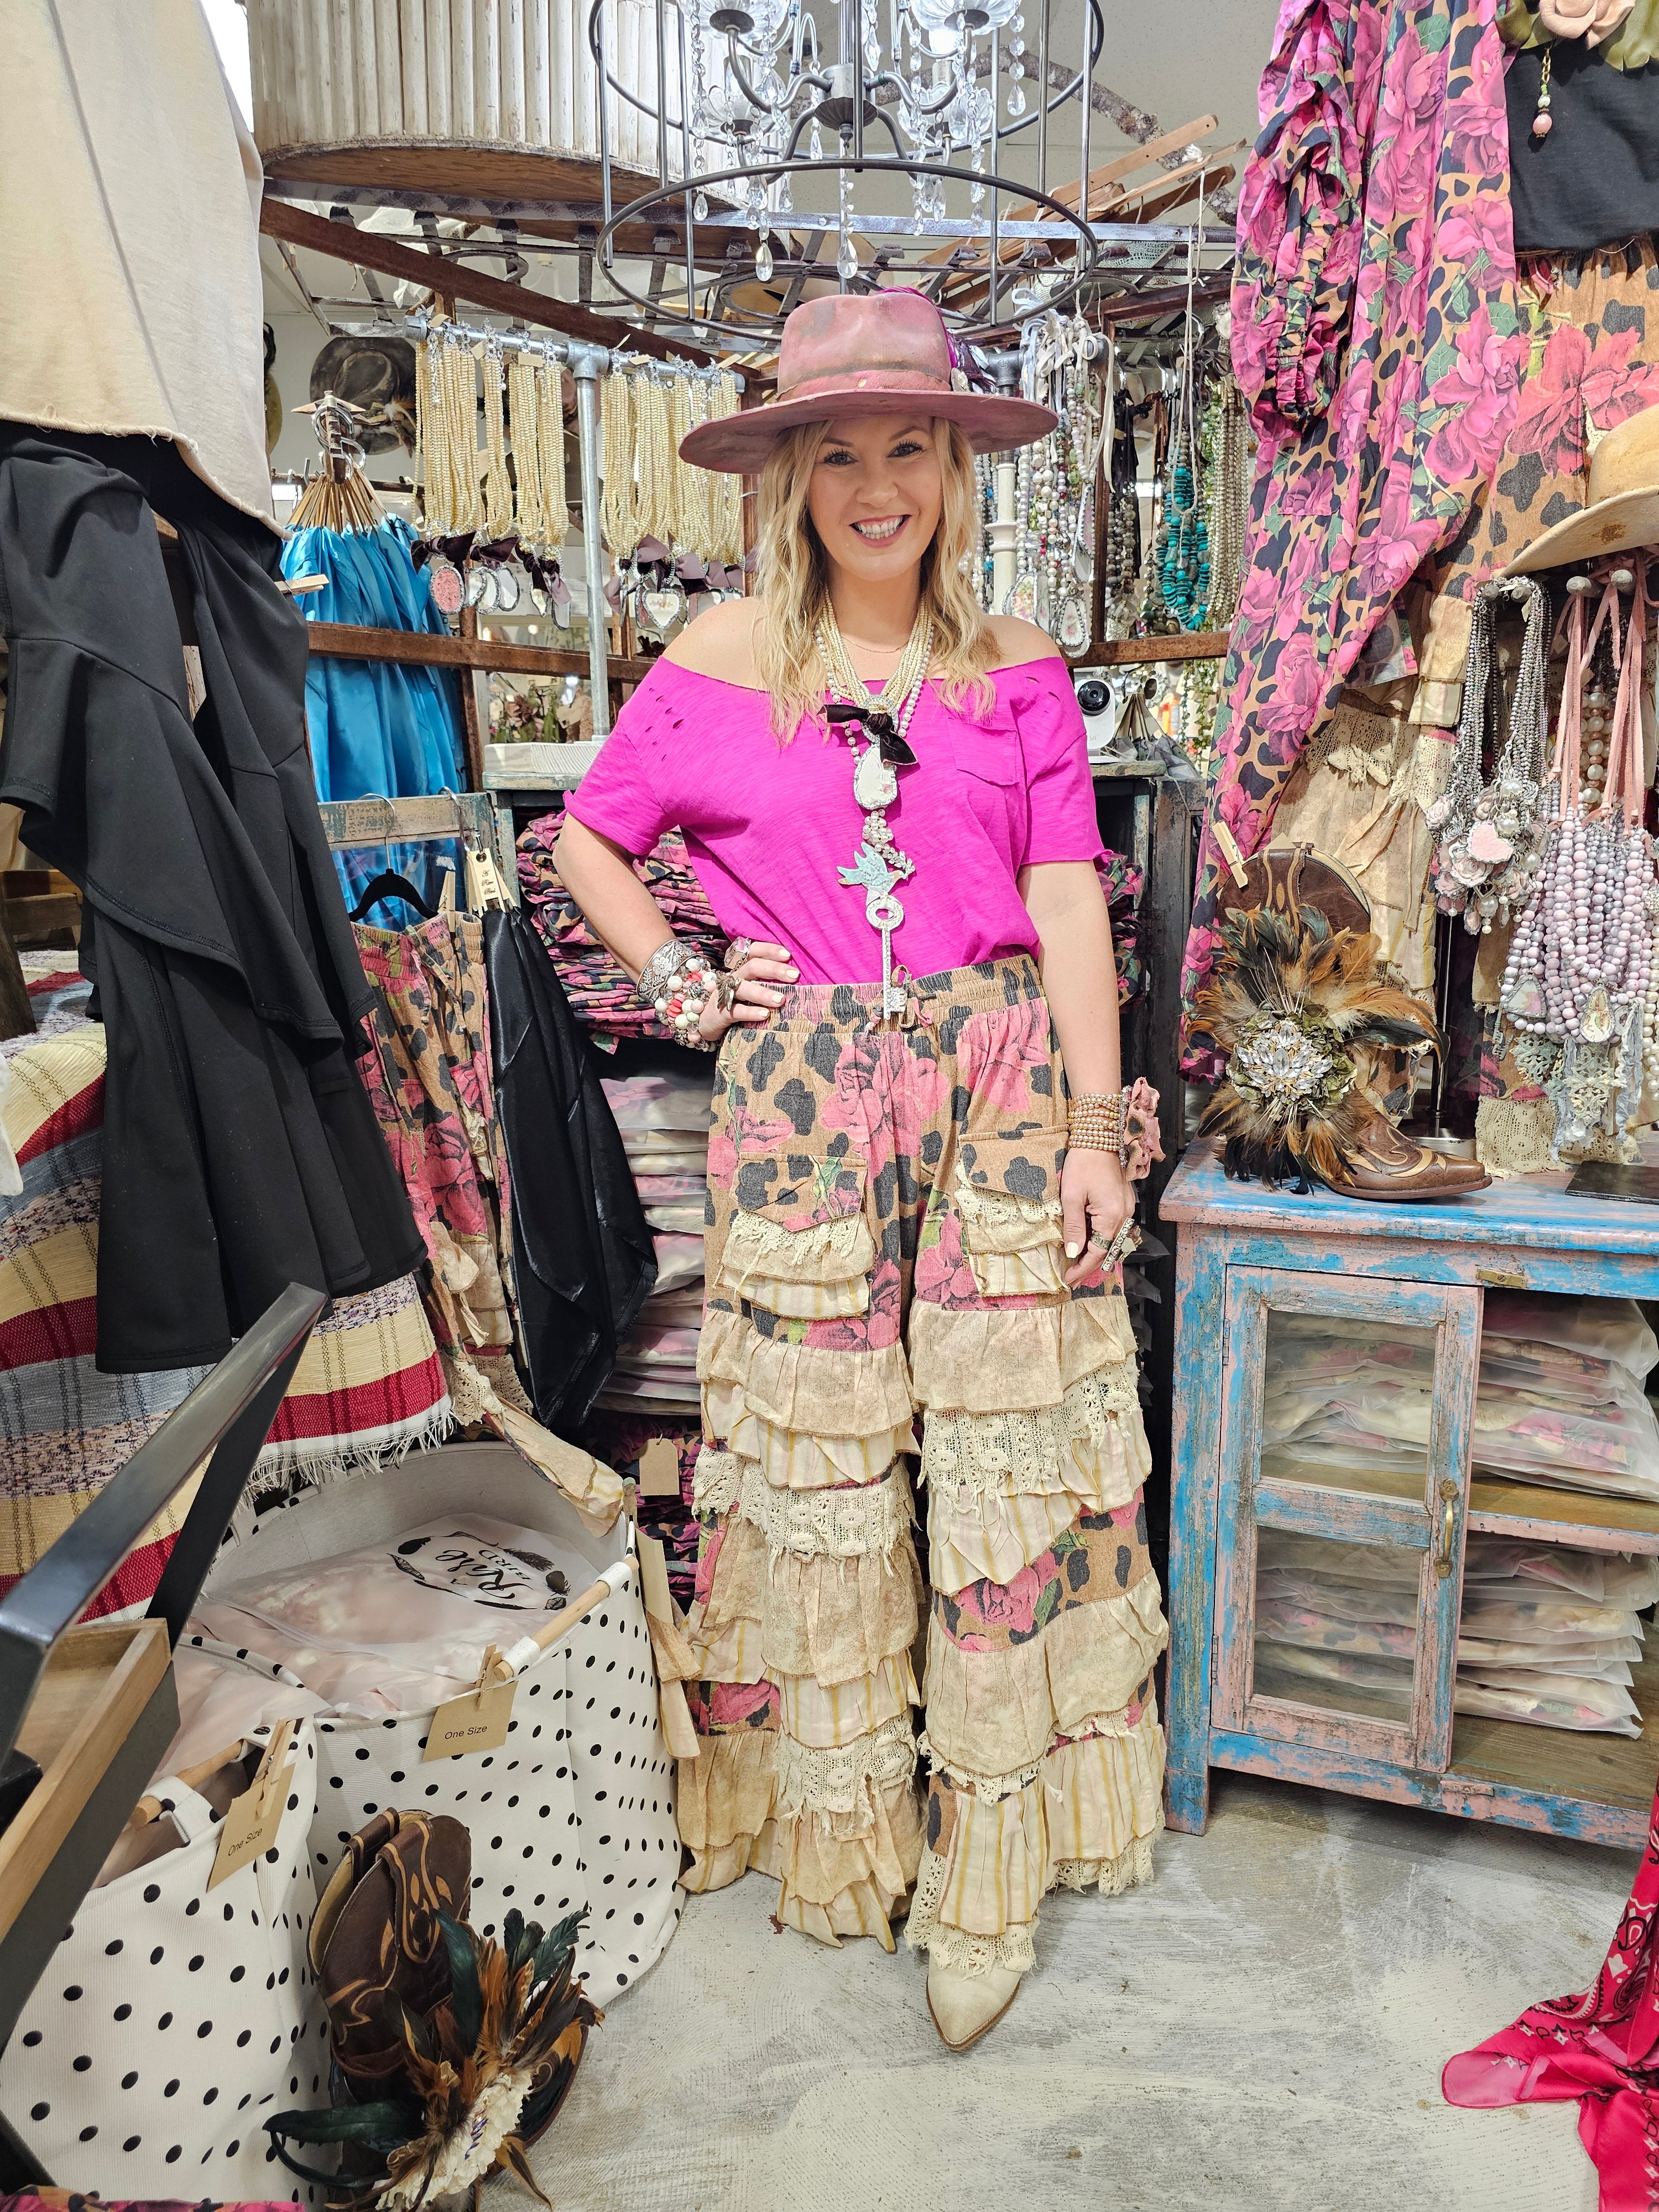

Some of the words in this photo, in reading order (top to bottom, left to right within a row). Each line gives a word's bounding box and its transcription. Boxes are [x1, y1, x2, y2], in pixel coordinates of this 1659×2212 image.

[478, 1549, 532, 1580] BIRD
[445, 1731, 465, 1740] One
[467, 1725, 488, 1735] Size
[228, 1840, 244, 1856] One
[246, 1827, 263, 1844] Size
